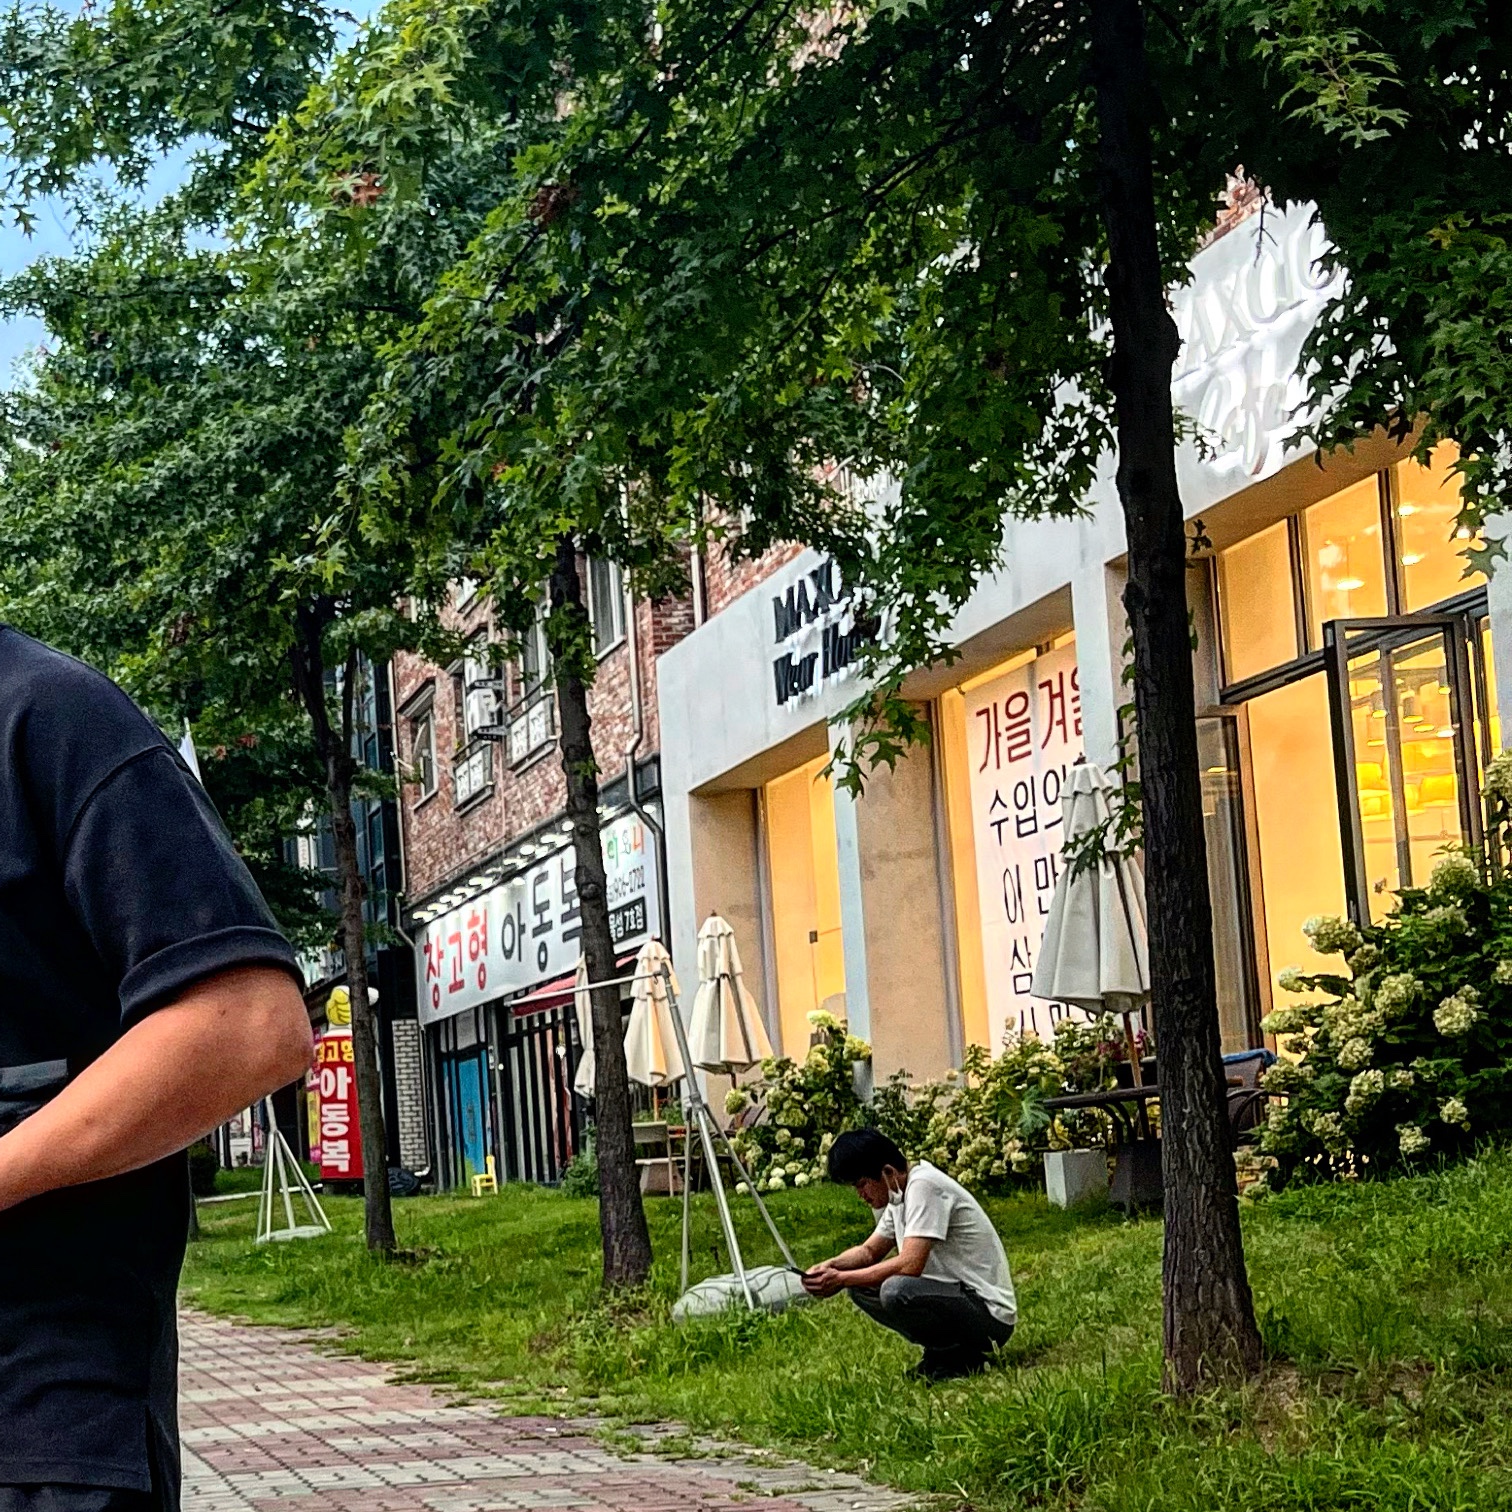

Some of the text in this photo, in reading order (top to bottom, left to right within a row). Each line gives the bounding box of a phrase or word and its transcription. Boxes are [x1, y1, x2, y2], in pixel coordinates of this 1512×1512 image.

[976, 690, 1032, 774] 가을
[989, 764, 1066, 846] 수입의
[424, 907, 488, 1010] 창고형
[320, 1066, 352, 1173] 아동복
